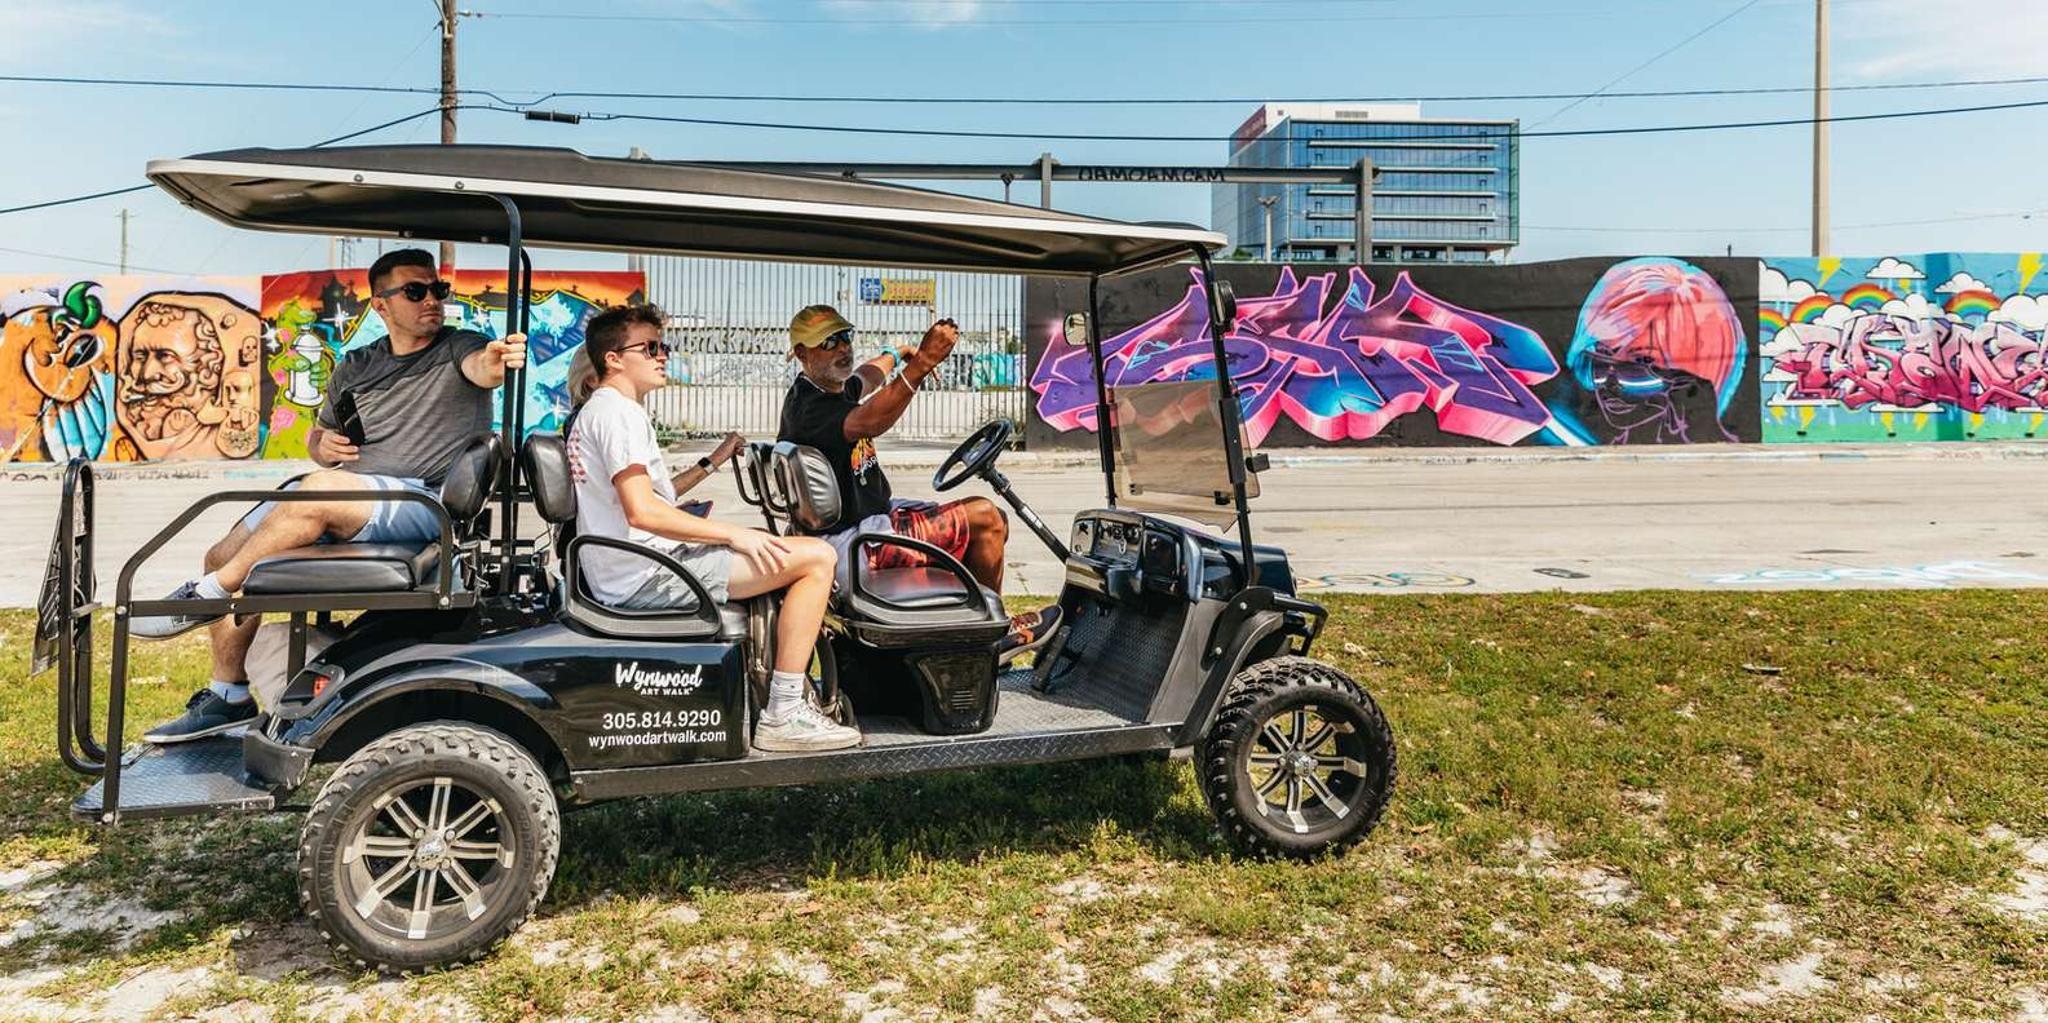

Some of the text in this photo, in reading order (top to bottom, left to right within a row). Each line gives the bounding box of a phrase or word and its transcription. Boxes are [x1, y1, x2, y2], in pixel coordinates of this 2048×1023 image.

[615, 661, 703, 690] Wynwood
[640, 688, 659, 696] ART
[602, 709, 721, 730] 305.814.9290
[588, 730, 727, 749] wynwoodartwalk.com
